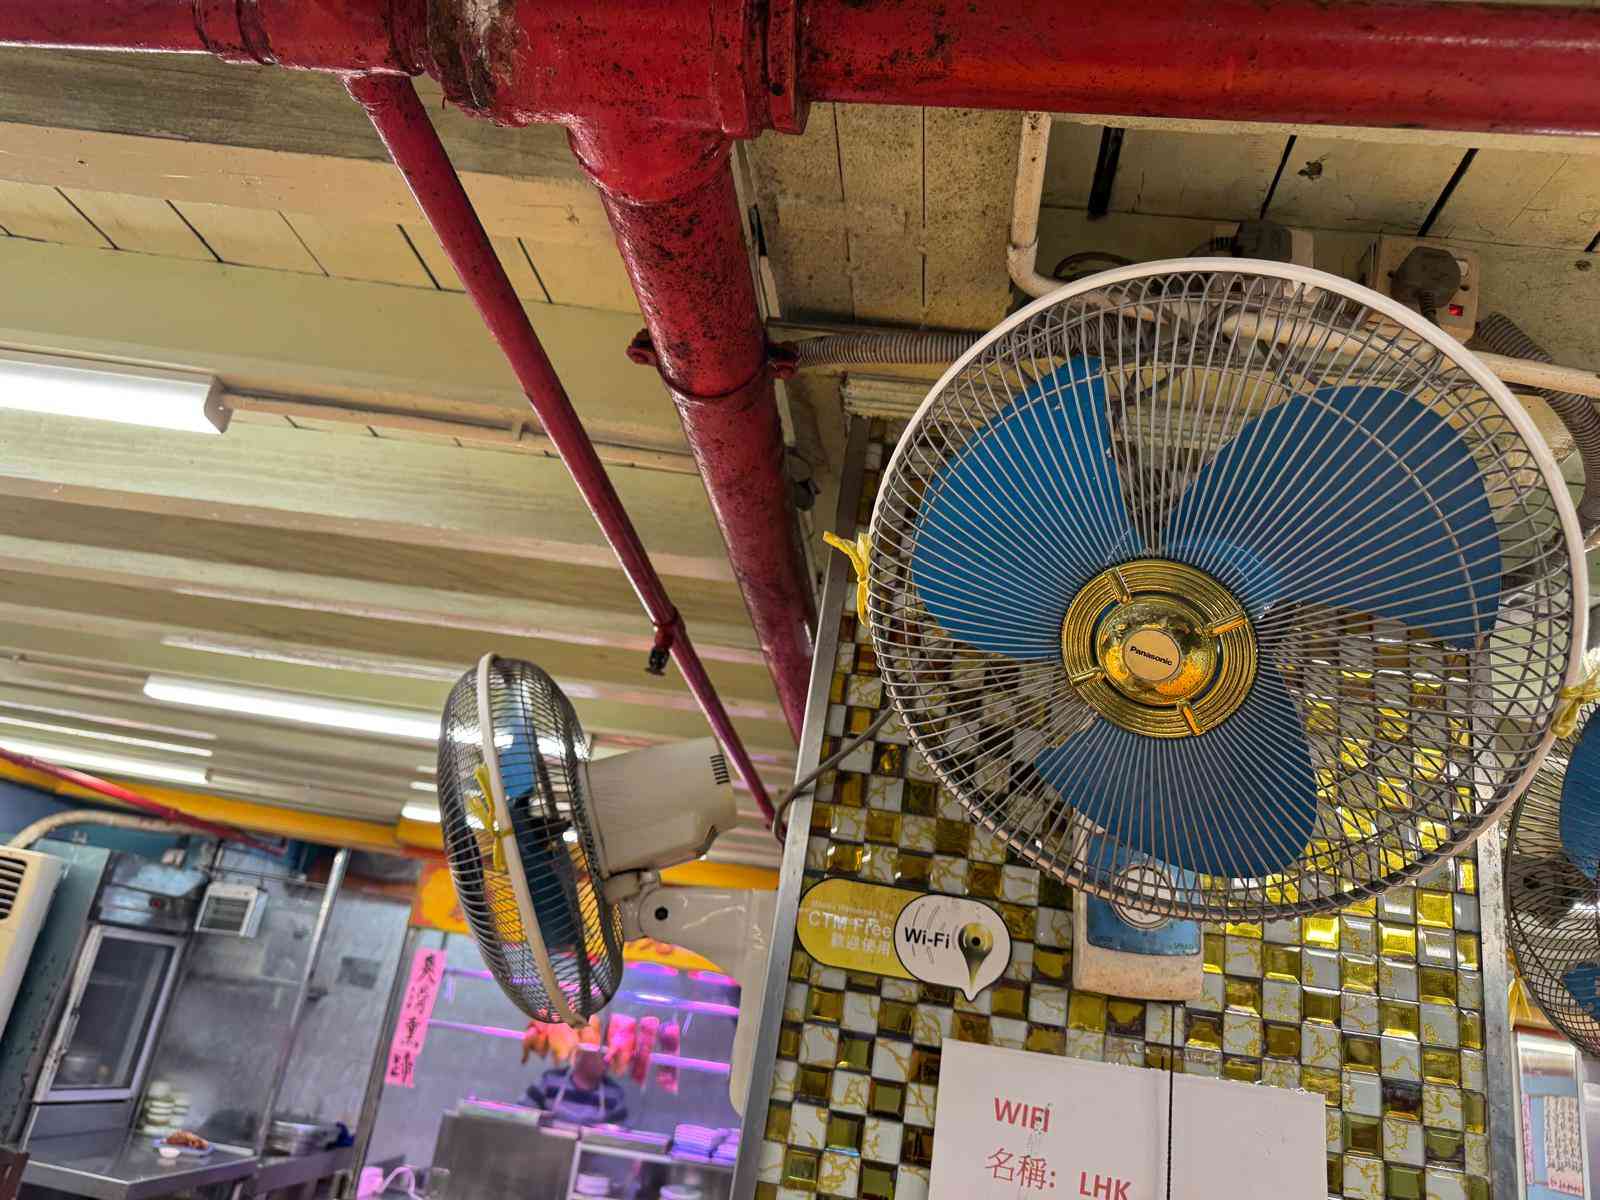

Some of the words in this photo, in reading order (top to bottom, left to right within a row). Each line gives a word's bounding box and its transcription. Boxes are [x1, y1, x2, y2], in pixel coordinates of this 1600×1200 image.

[1130, 646, 1172, 666] Panasonic
[904, 927, 951, 949] Wi-Fi
[1079, 1171, 1132, 1200] LHK
